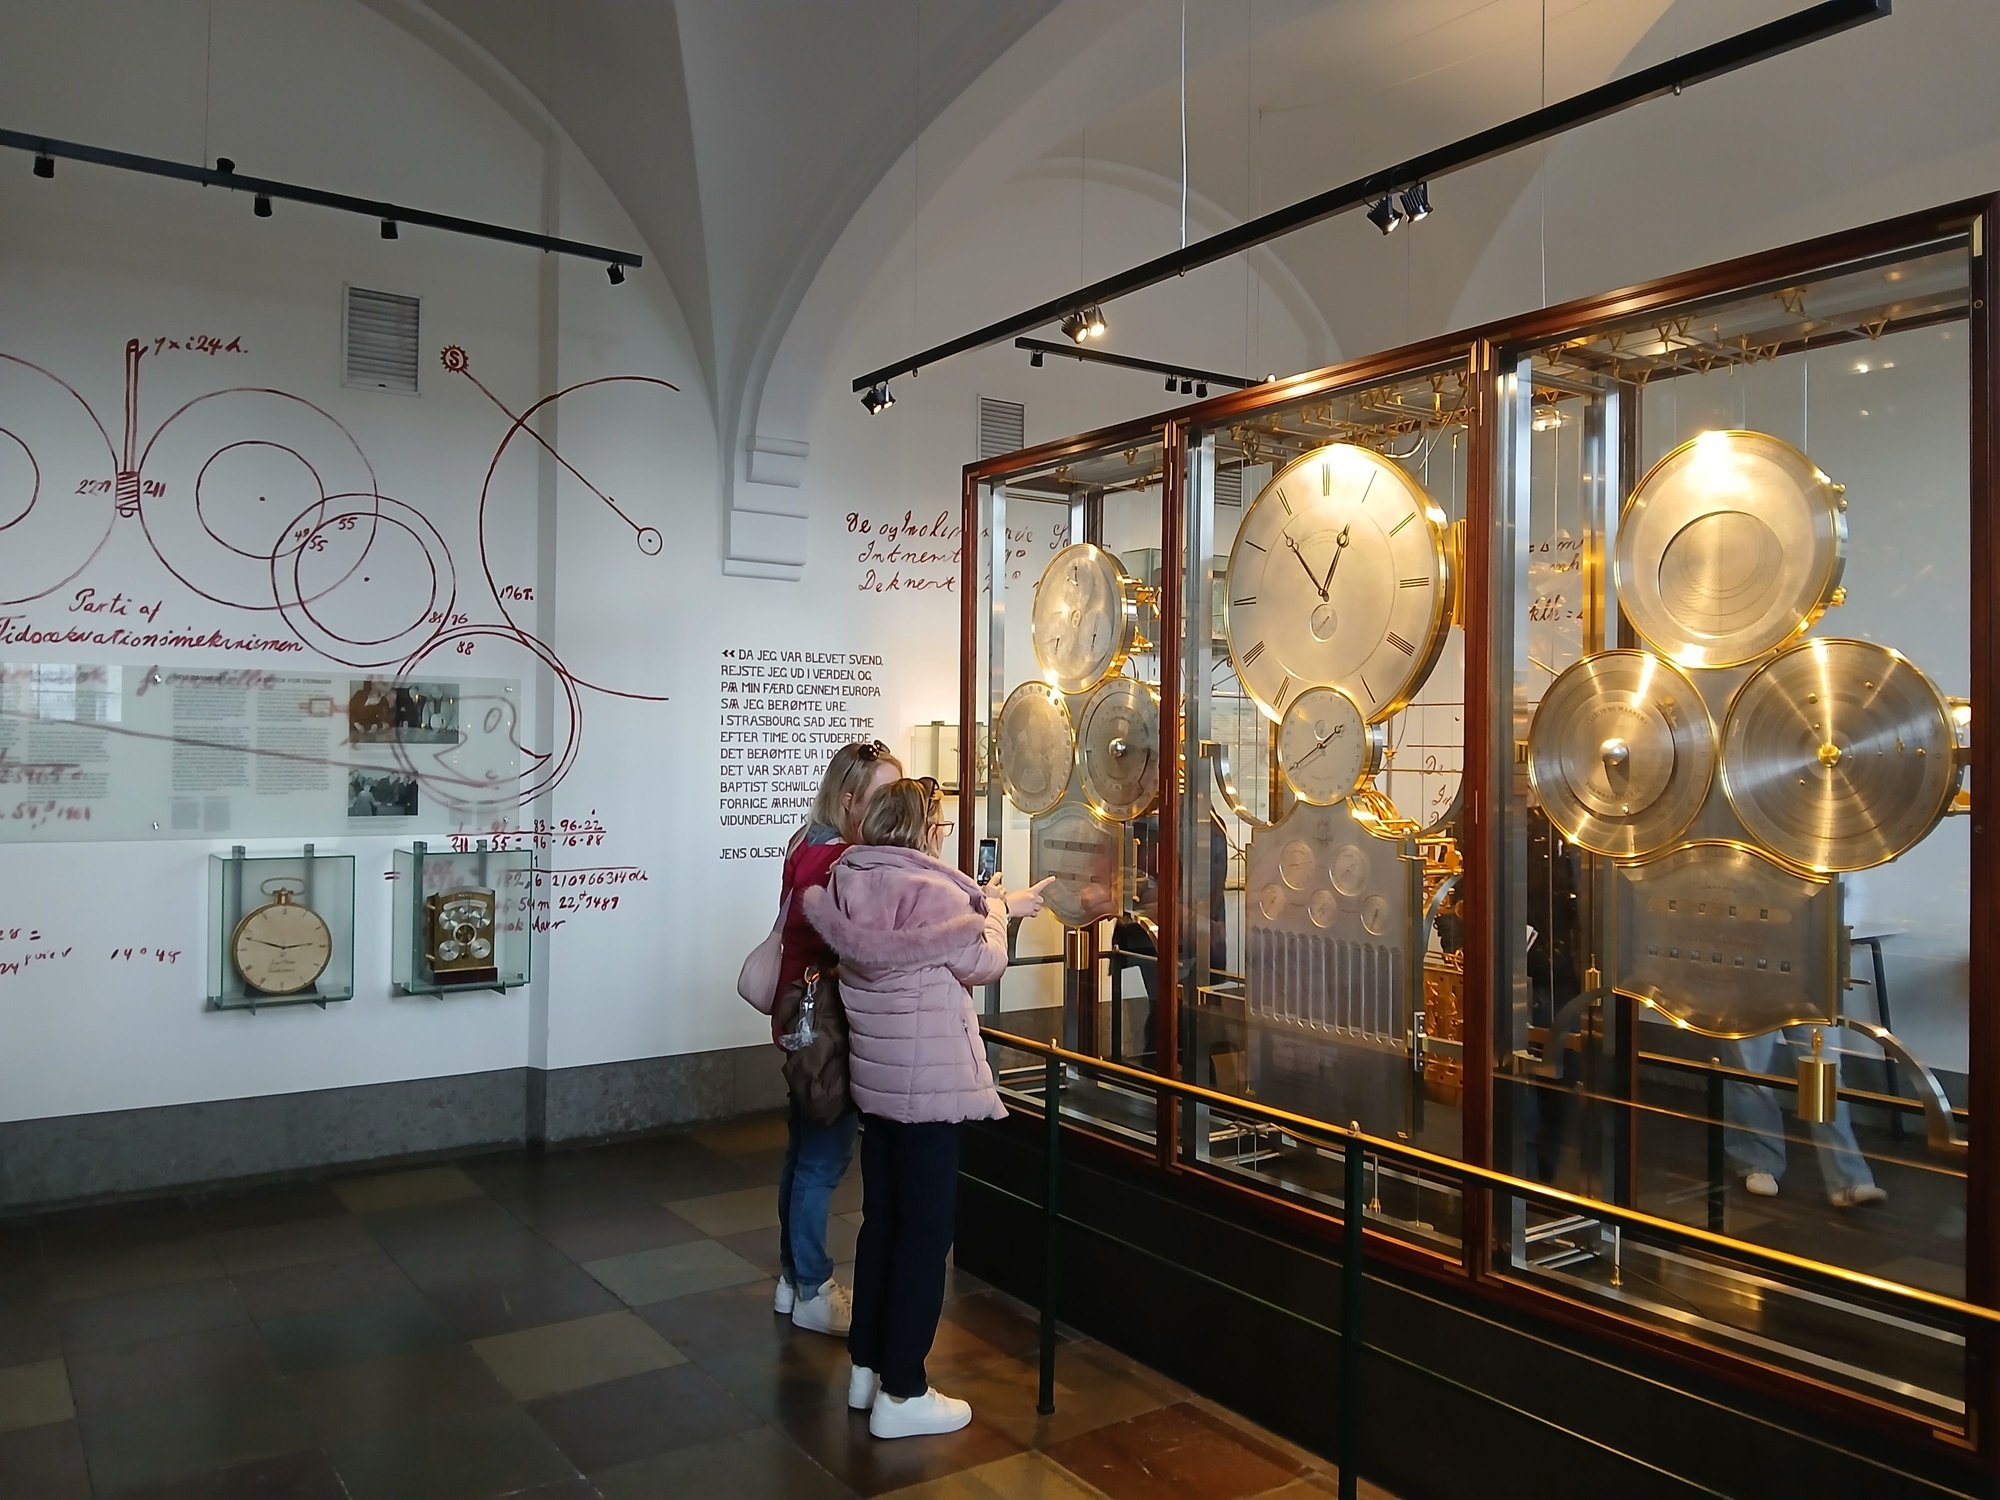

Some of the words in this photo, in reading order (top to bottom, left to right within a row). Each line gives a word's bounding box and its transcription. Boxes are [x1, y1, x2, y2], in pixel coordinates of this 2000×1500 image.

[338, 516, 359, 530] 55
[308, 535, 329, 552] 55
[69, 588, 132, 616] Parti
[738, 649, 754, 661] DA
[757, 650, 777, 662] JEG
[780, 651, 802, 663] VAR
[805, 652, 846, 664] BLEVET
[721, 665, 765, 677] REJSTE
[767, 666, 788, 678] JEG
[790, 668, 805, 679] UD
[857, 671, 873, 681] OG
[741, 682, 761, 694] MIN
[763, 683, 794, 695] FÆRD
[796, 684, 840, 696] GENNEM
[842, 685, 881, 697] EUROPA
[743, 698, 764, 710] JEG
[767, 699, 822, 712] BERØMTE
[726, 715, 800, 727] STRASBOURG
[803, 716, 825, 728] SAD
[827, 716, 847, 728] JEG
[849, 717, 874, 728] TIME
[720, 731, 758, 744] EFTER
[762, 732, 789, 743] TIME
[791, 732, 807, 743] OG
[720, 749, 744, 760] DET
[747, 748, 801, 760] BERØMTE
[804, 749, 818, 759] UR
[720, 765, 744, 776] DET
[748, 765, 769, 776] VAR
[772, 765, 810, 776] SKABT
[812, 765, 827, 775] AF
[720, 781, 768, 793] BAPTIST
[720, 797, 768, 809] FORRIGE
[720, 814, 797, 826] VIDUNDERLIGT
[719, 847, 747, 859] JENS
[750, 846, 786, 858] OLSEN
